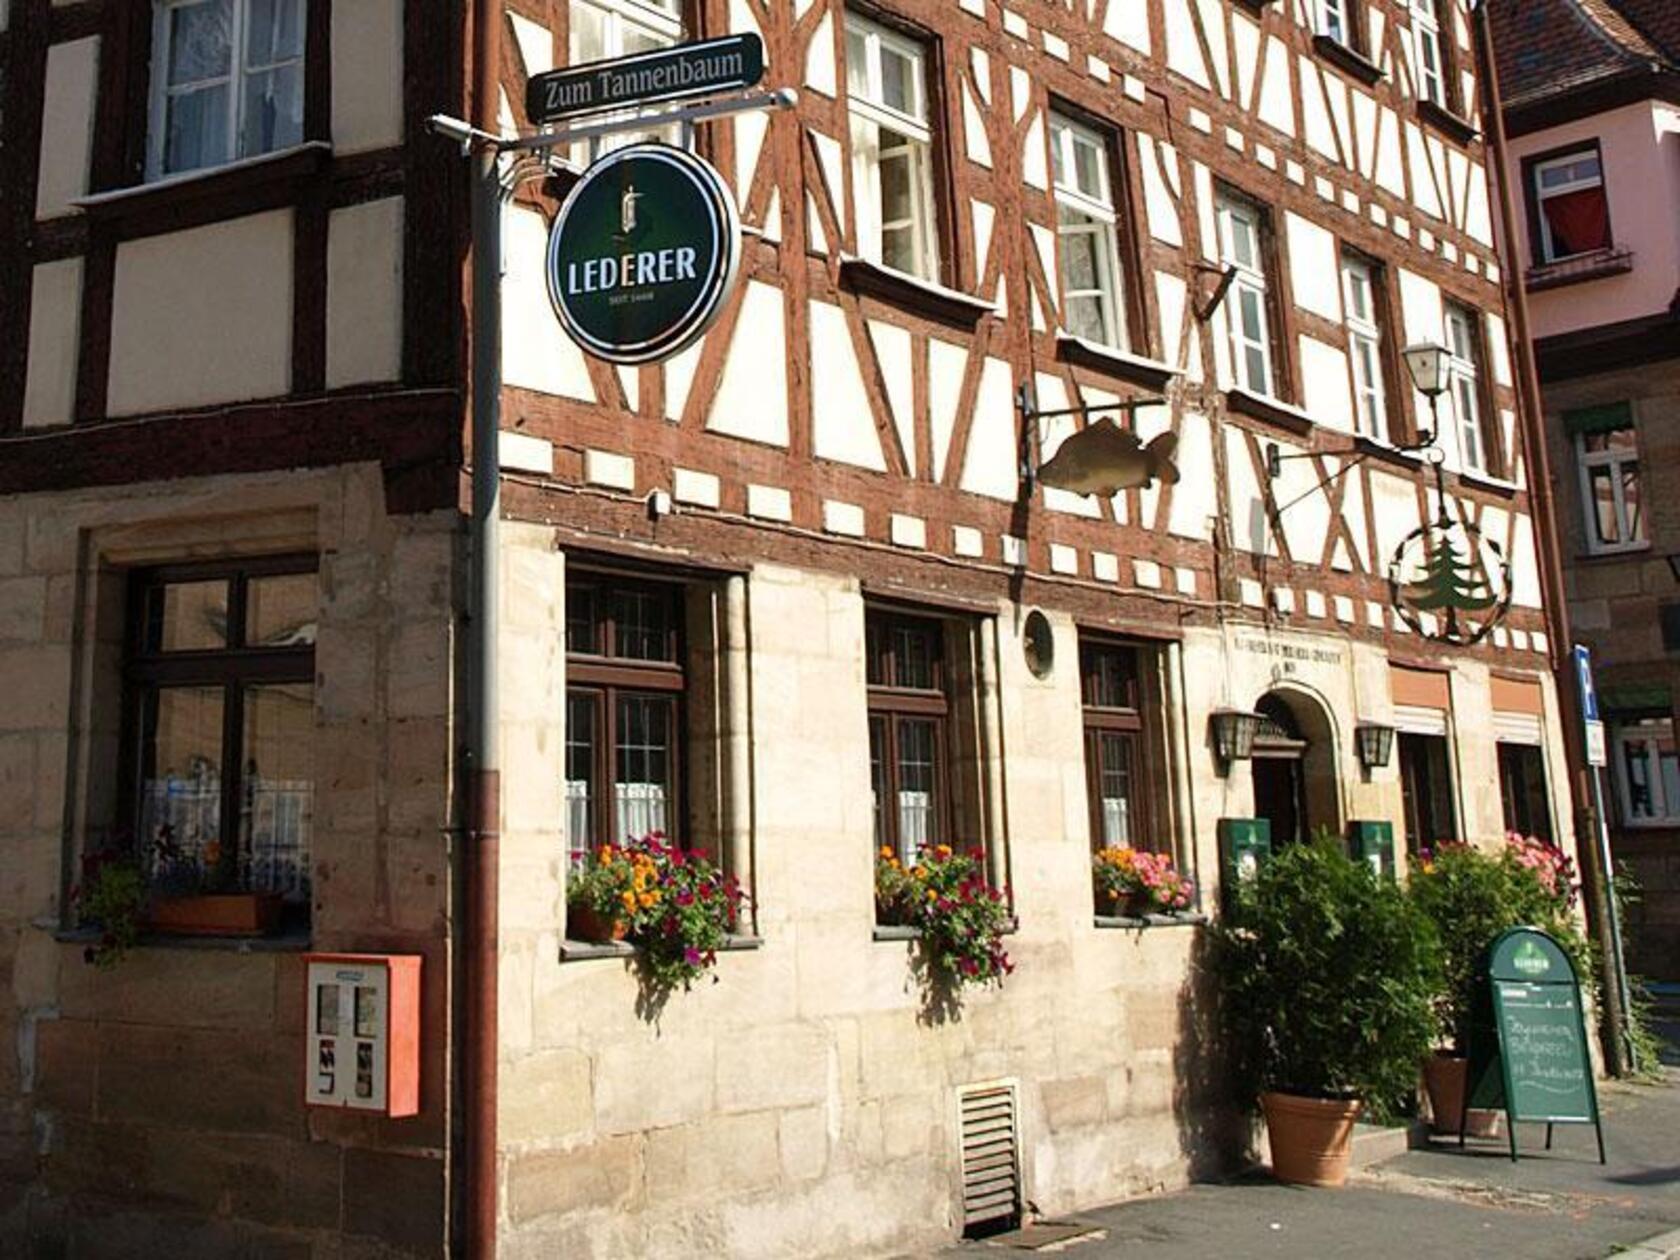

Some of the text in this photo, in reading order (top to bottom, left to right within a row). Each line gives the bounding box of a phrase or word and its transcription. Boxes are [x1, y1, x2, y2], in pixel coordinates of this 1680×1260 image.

[545, 53, 743, 109] Zum Tannenbaum
[568, 246, 697, 295] LEDERER
